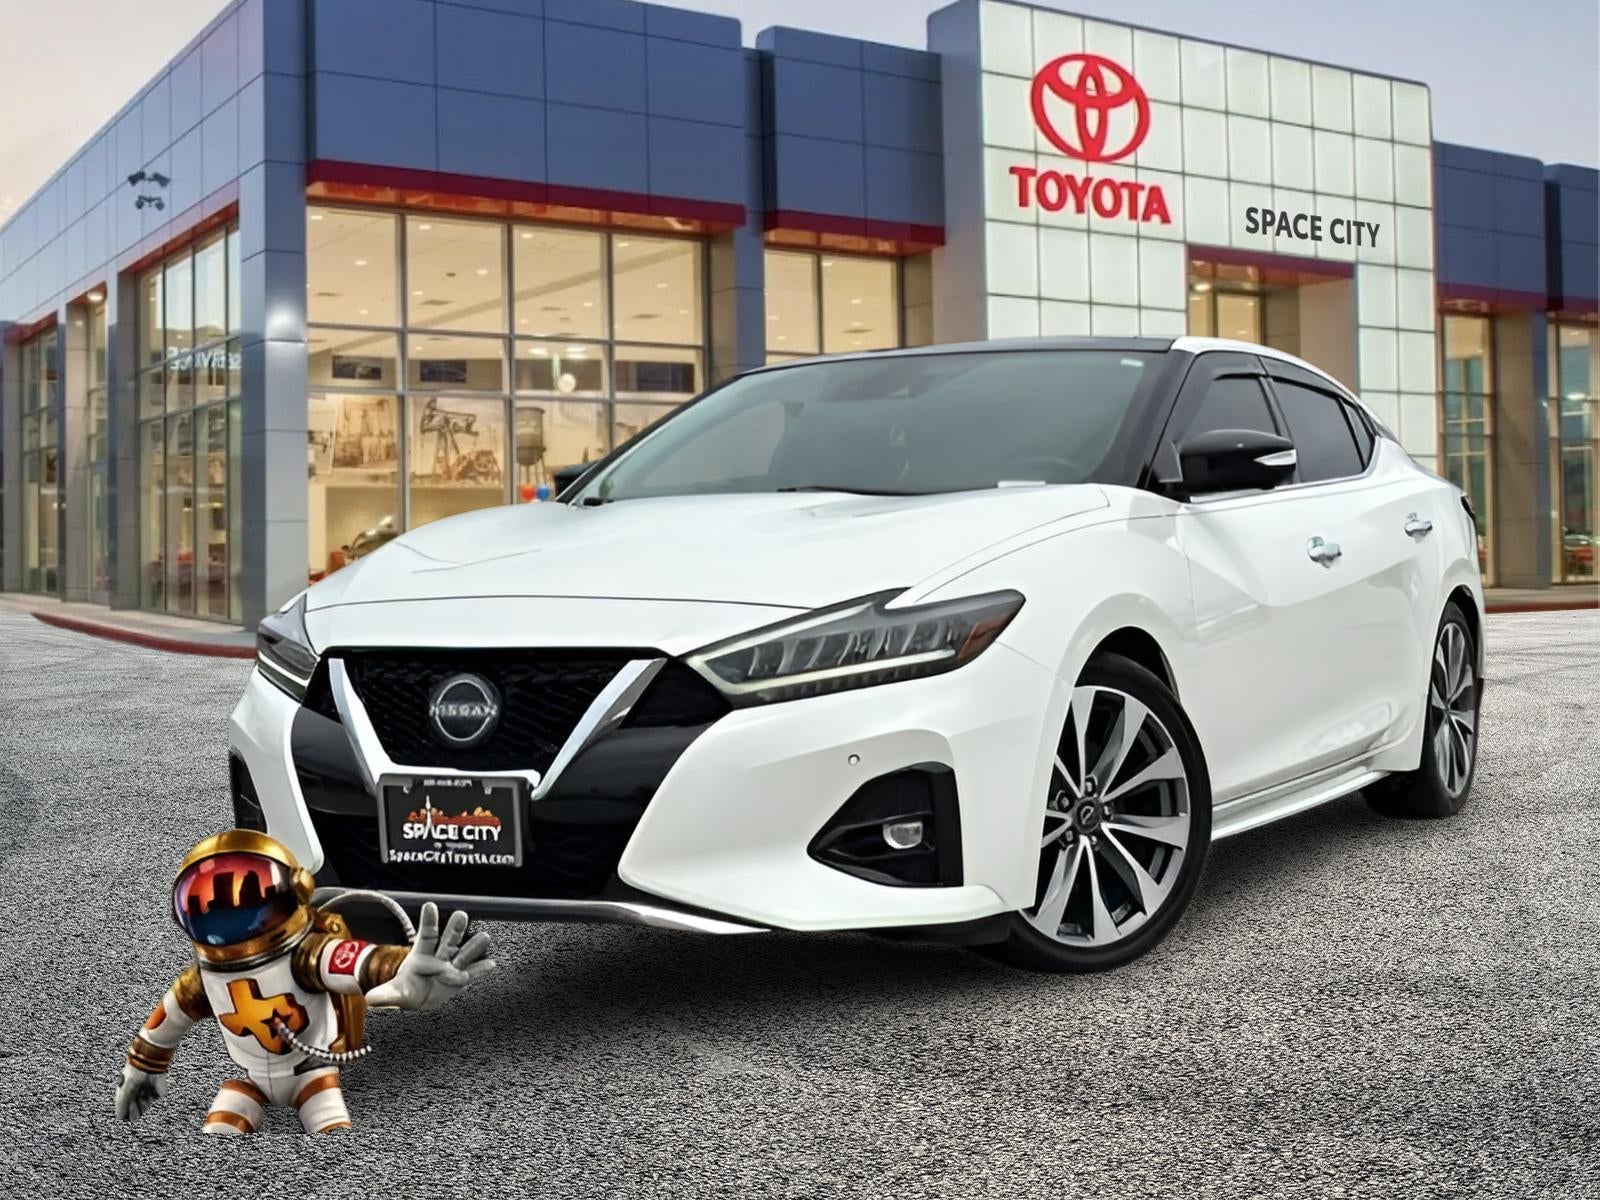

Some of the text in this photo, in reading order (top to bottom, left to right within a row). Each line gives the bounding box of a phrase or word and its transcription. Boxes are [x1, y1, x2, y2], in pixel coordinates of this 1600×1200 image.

[1009, 166, 1171, 224] TOYOTA
[1245, 206, 1380, 248] SPACE CITY
[429, 704, 497, 717] NISSAN
[402, 822, 501, 841] SPACE CITY
